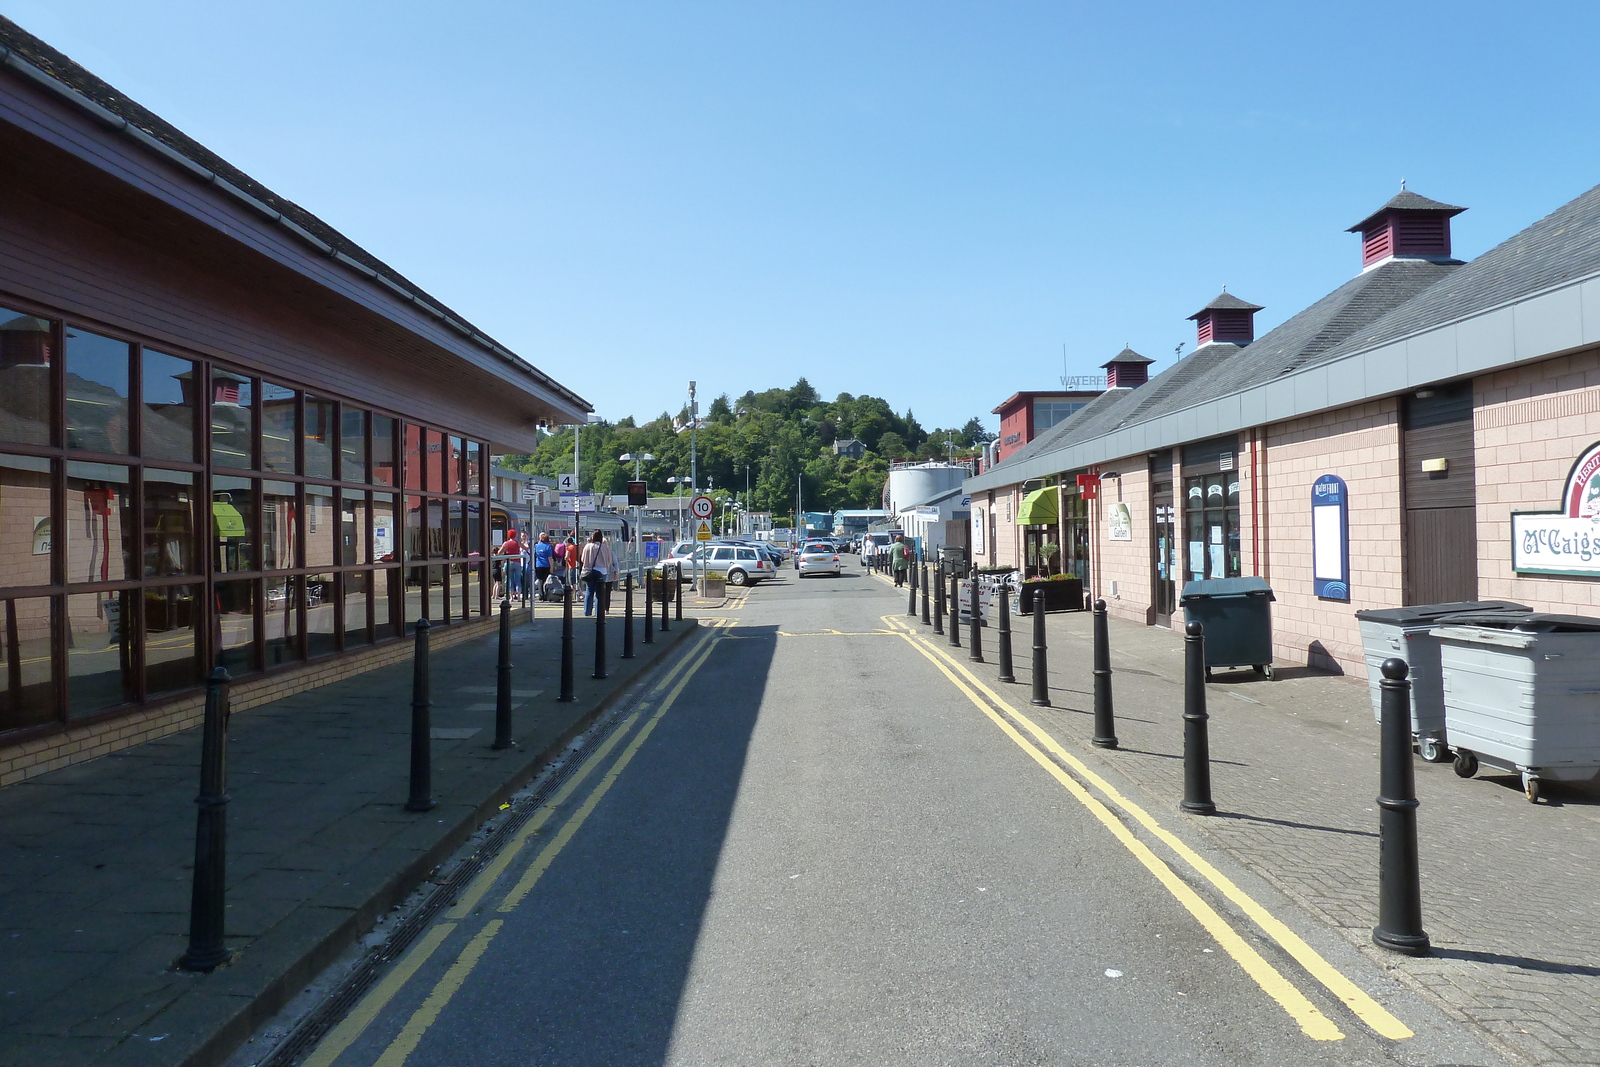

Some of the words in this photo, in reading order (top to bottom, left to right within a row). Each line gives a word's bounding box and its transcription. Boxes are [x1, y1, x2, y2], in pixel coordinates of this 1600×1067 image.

[562, 476, 571, 487] 4
[697, 502, 709, 512] 10
[1523, 527, 1600, 561] McCaig's
